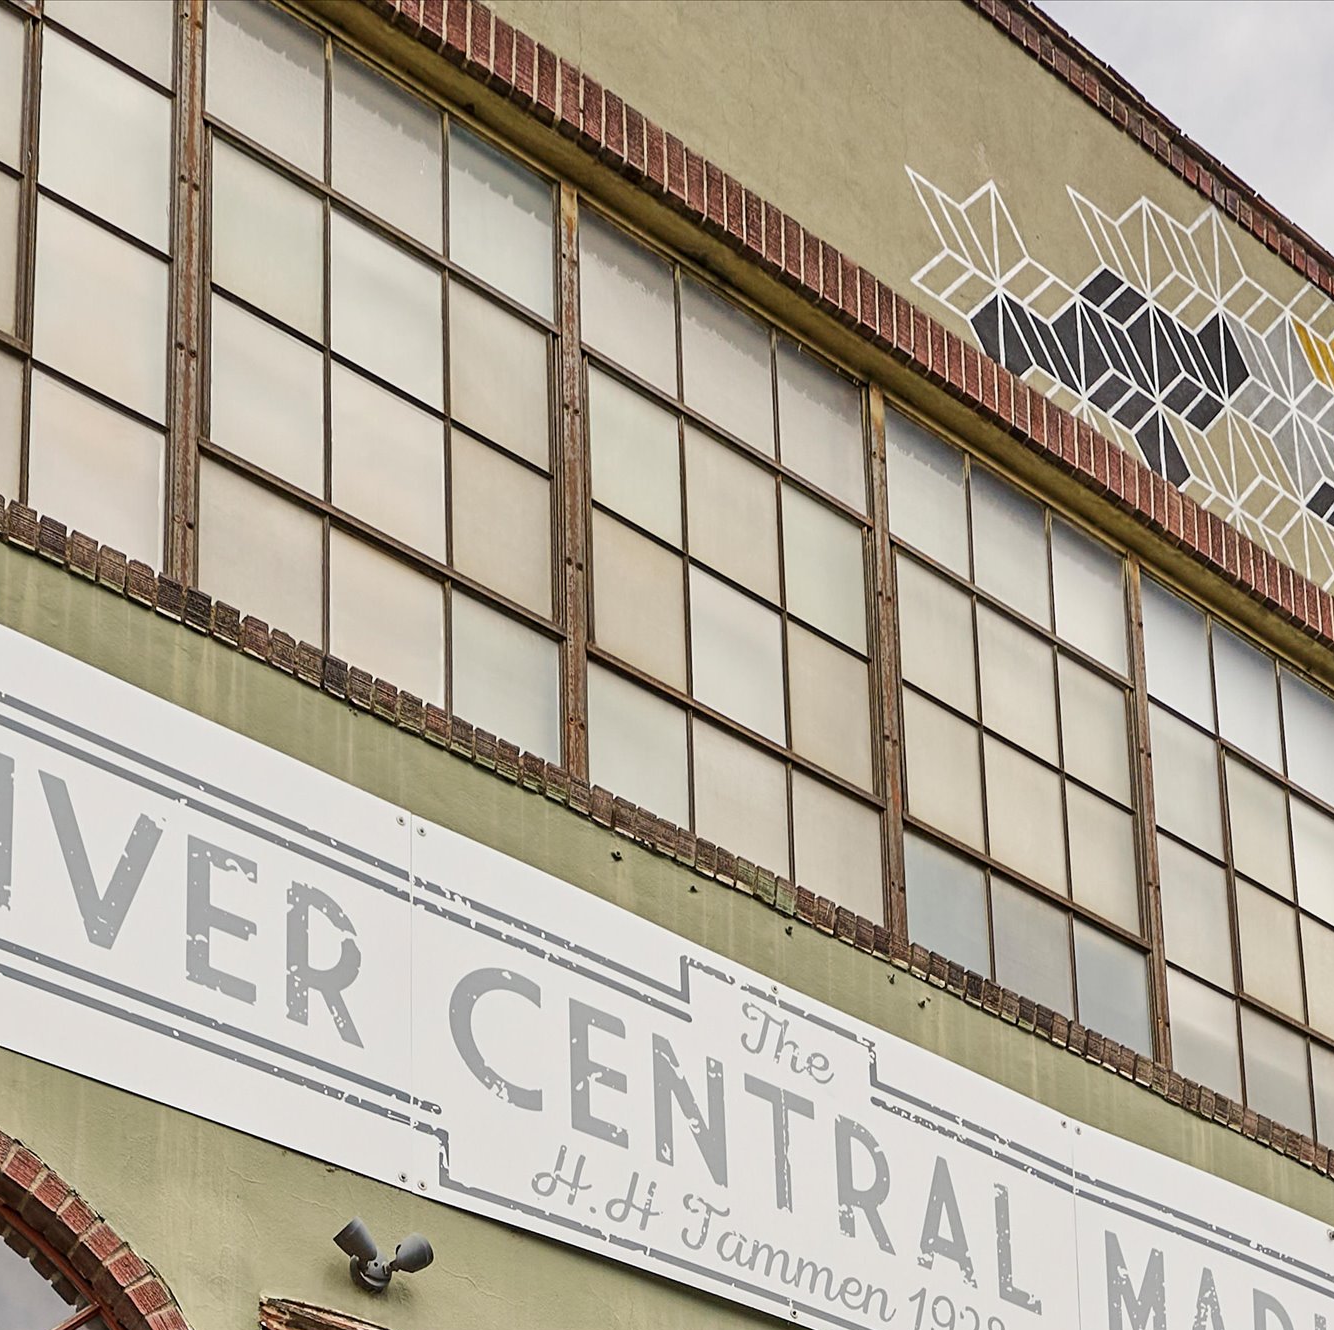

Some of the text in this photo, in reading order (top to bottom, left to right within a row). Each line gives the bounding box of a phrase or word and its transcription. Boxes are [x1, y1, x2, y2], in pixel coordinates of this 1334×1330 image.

[740, 1000, 835, 1085] The
[449, 967, 1043, 1317] CENTRAL
[681, 1193, 898, 1323] Tammen
